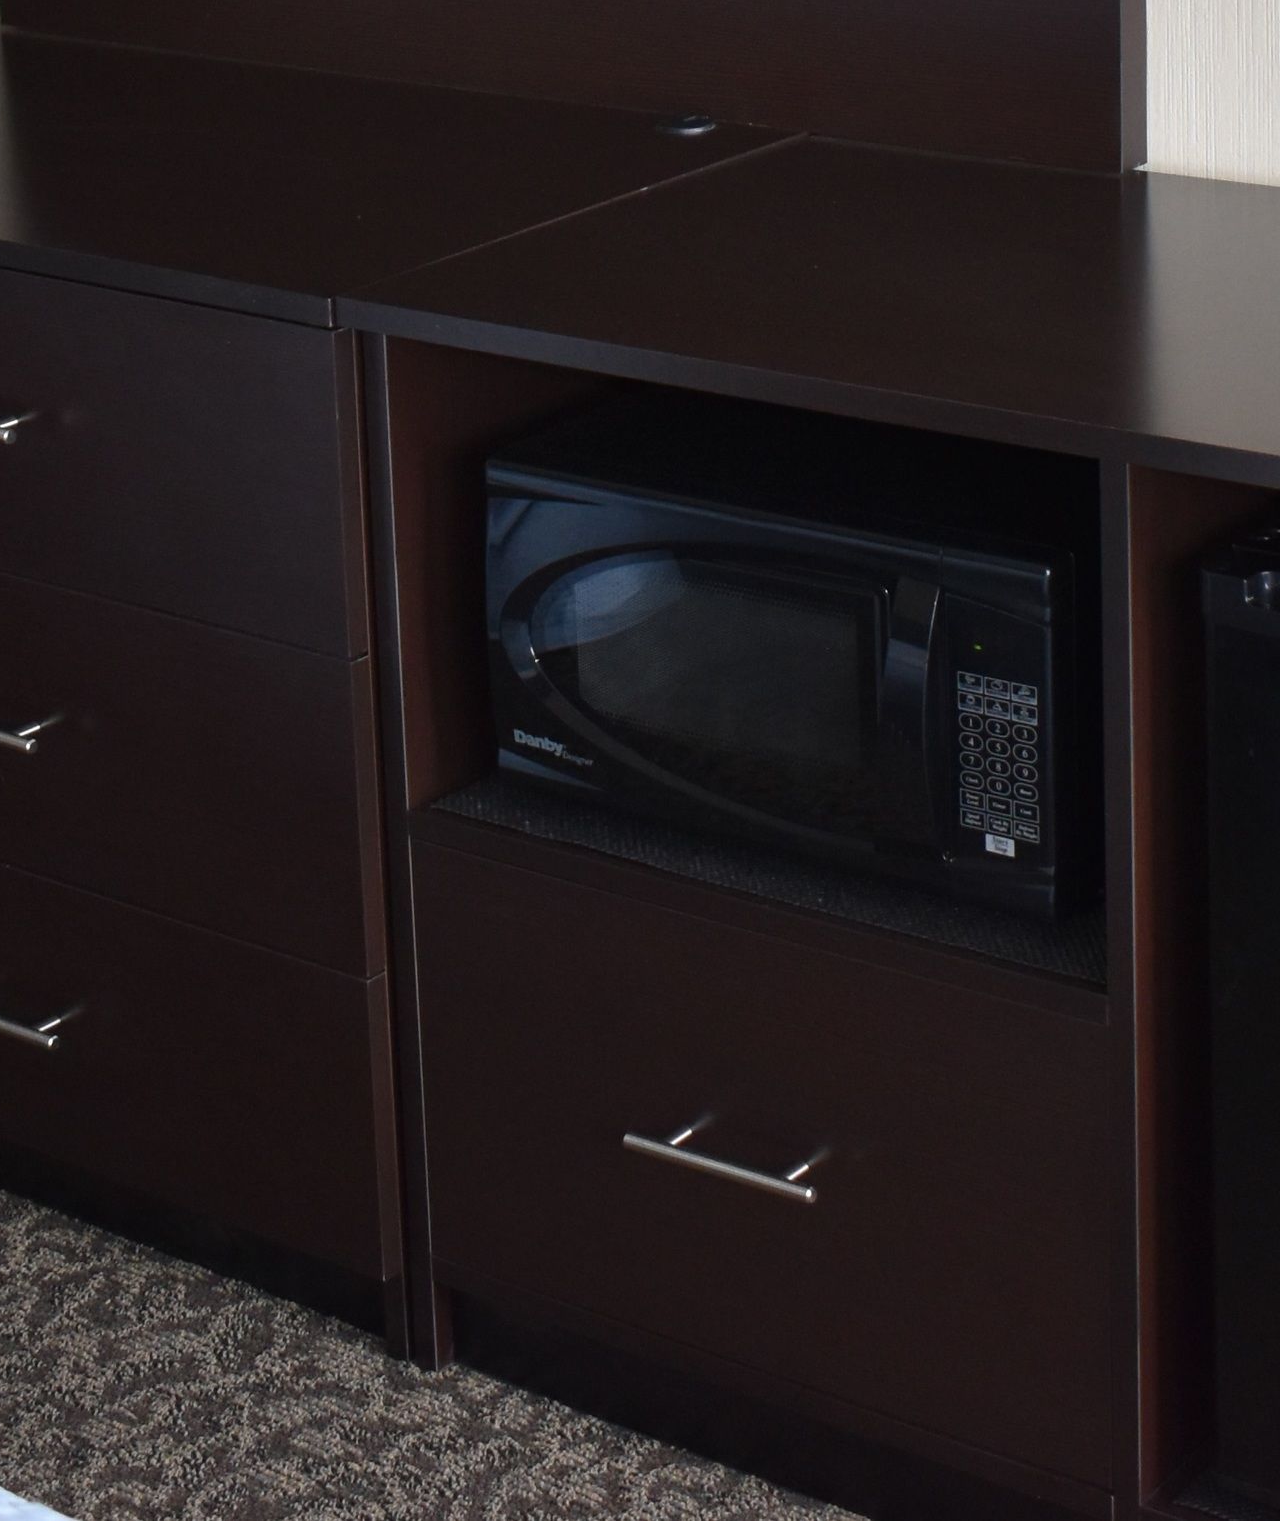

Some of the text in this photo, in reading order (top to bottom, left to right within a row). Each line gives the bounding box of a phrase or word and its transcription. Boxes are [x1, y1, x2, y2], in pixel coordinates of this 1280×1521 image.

[969, 718, 973, 727] 1
[995, 723, 1000, 733] 2
[513, 728, 563, 756] Danby
[968, 737, 974, 746] 4
[1022, 749, 1028, 758] 6
[1022, 768, 1028, 777] 9
[995, 782, 1002, 791] 0
